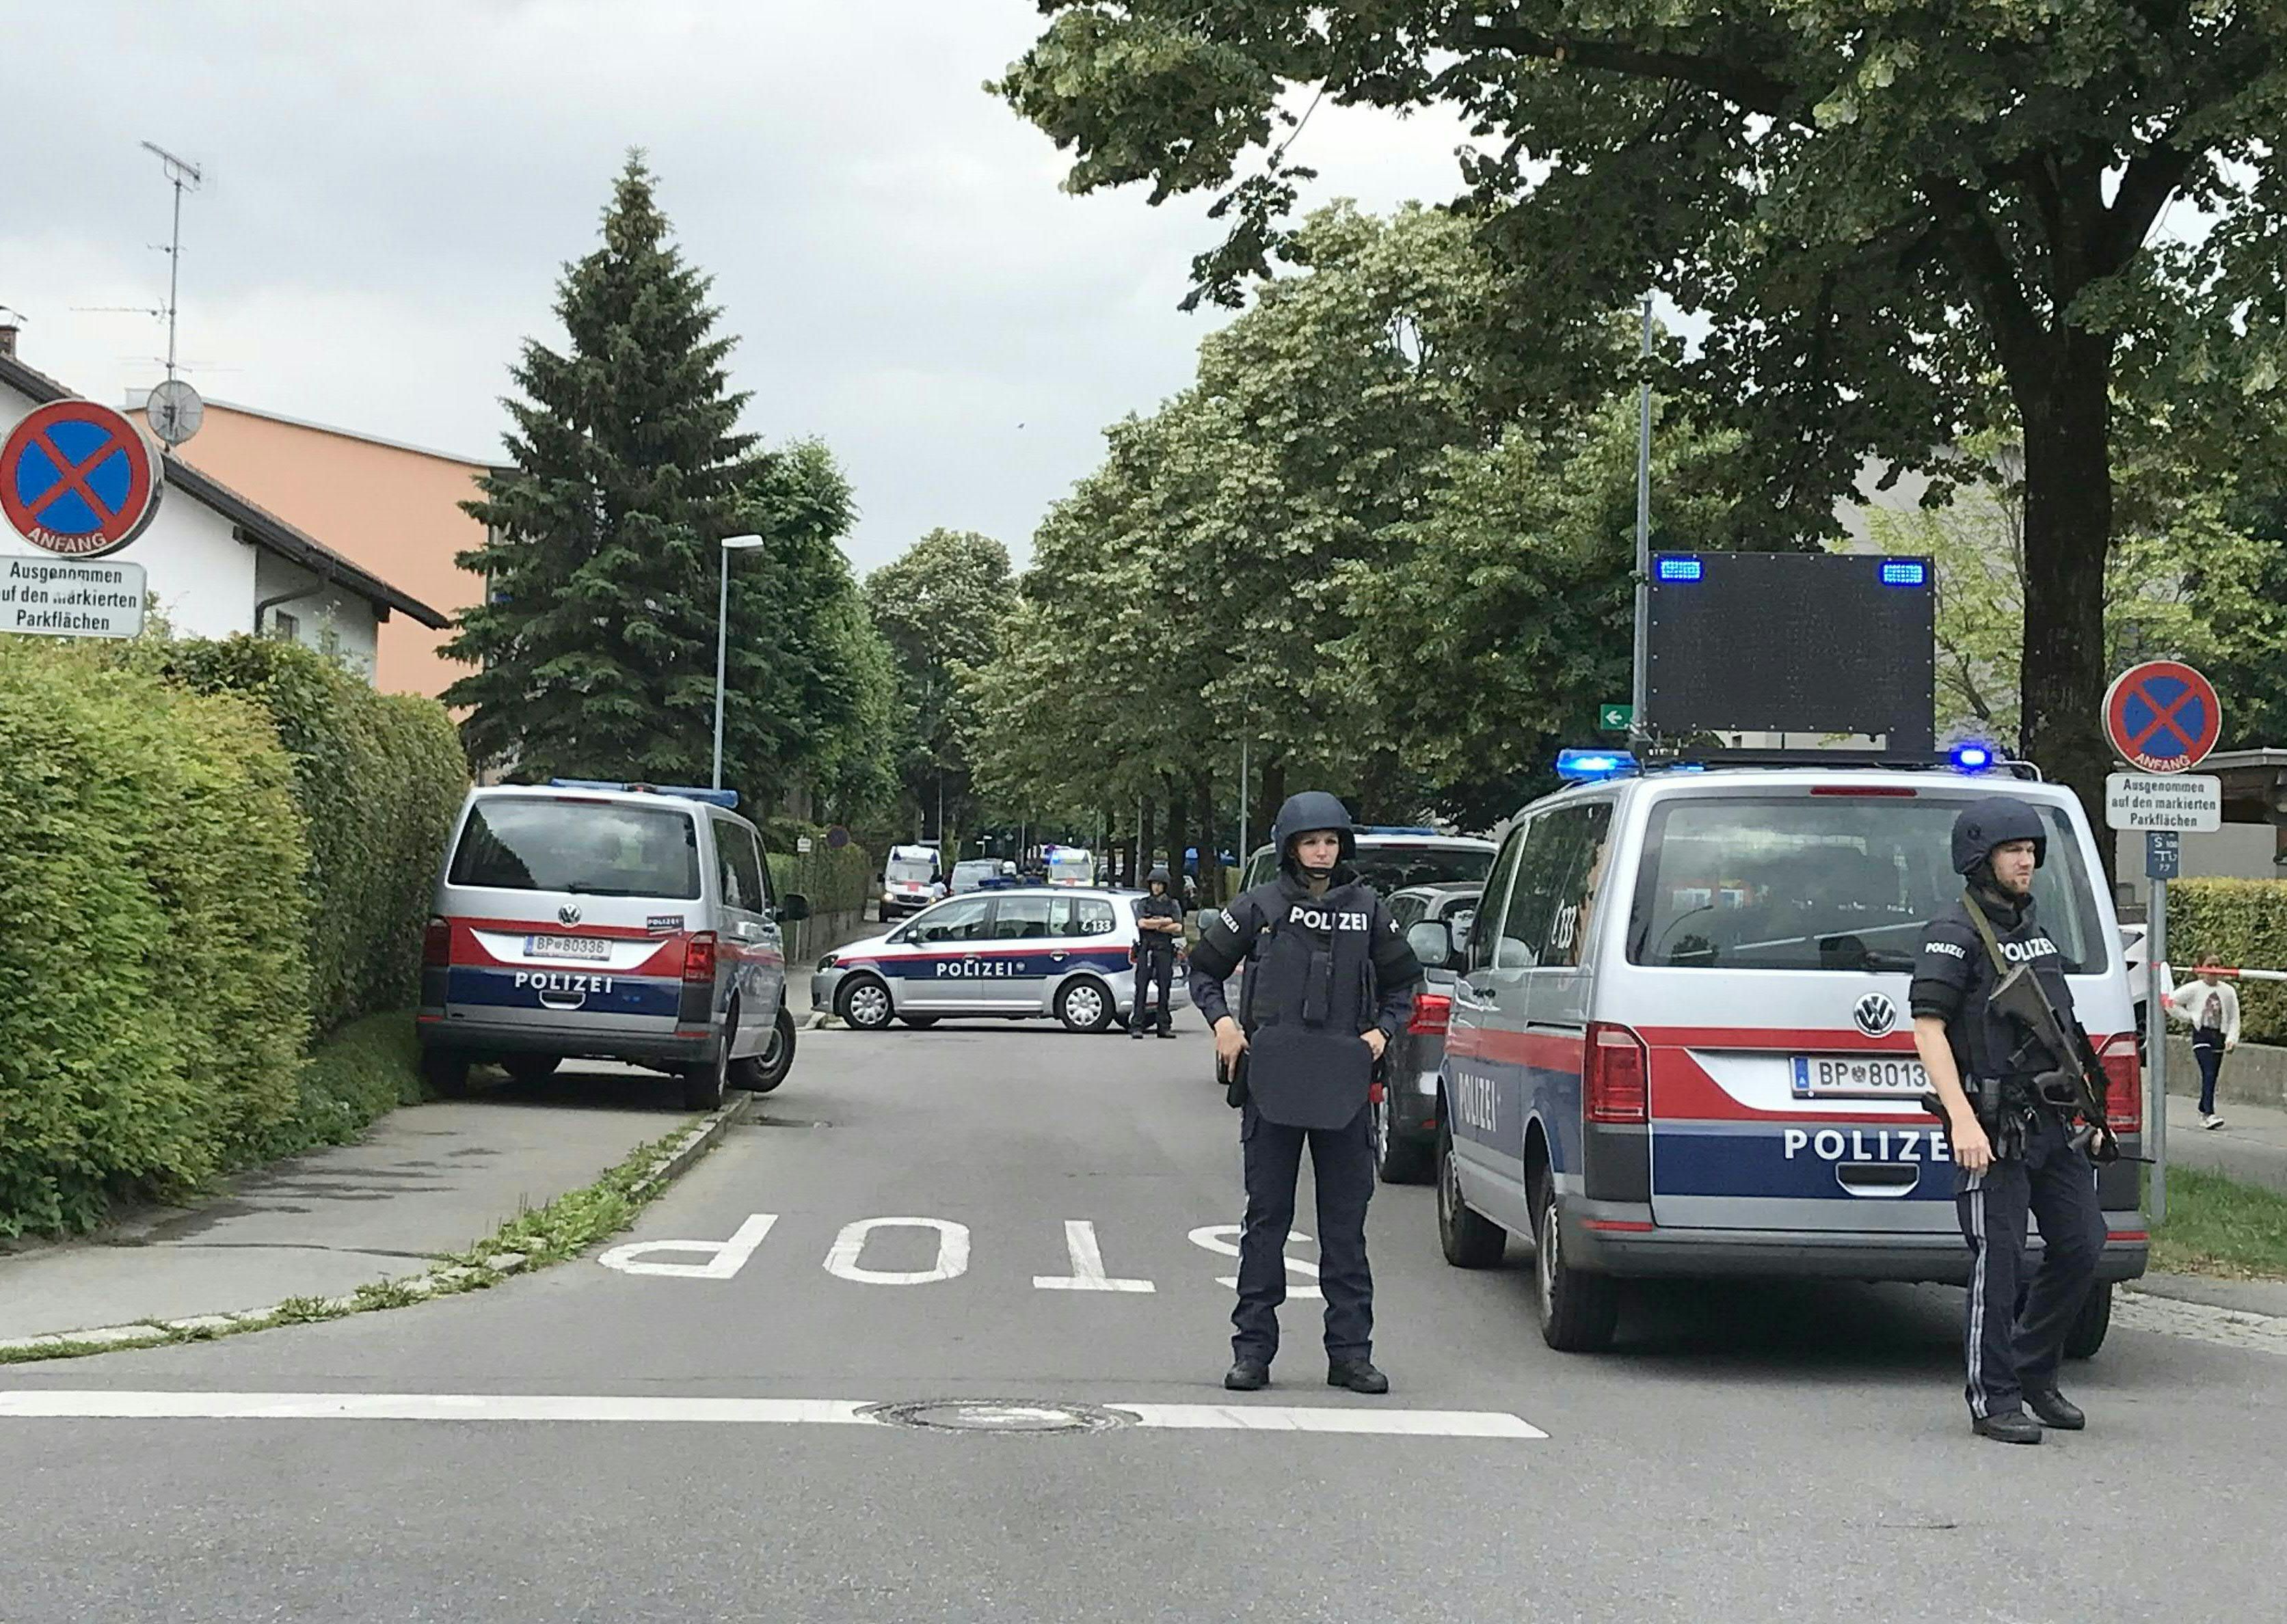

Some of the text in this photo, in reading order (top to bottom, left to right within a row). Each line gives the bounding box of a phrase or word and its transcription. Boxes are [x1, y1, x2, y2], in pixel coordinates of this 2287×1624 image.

[27, 527, 107, 552] ANFANG
[10, 561, 122, 584] Ausgenommen
[0, 585, 16, 601] uf
[21, 586, 48, 603] den
[16, 609, 110, 630] Parkflächen
[2134, 753, 2191, 771] ANFANG
[2123, 778, 2205, 794] Ausgenommen
[2111, 796, 2217, 811] auf den markierten
[2130, 813, 2197, 827] Parkflächen
[1092, 919, 1112, 932] 133
[1289, 906, 1367, 931] POLIZEI
[537, 936, 605, 953] BP 80336
[1925, 942, 1966, 960] POLIZEI
[937, 960, 1013, 977] POLIZEI
[515, 971, 613, 994] POLIZEI
[1819, 1061, 1927, 1087] BP 8013
[1458, 1072, 1497, 1133] POLIZEI
[1784, 1129, 1950, 1161] POLIZE
